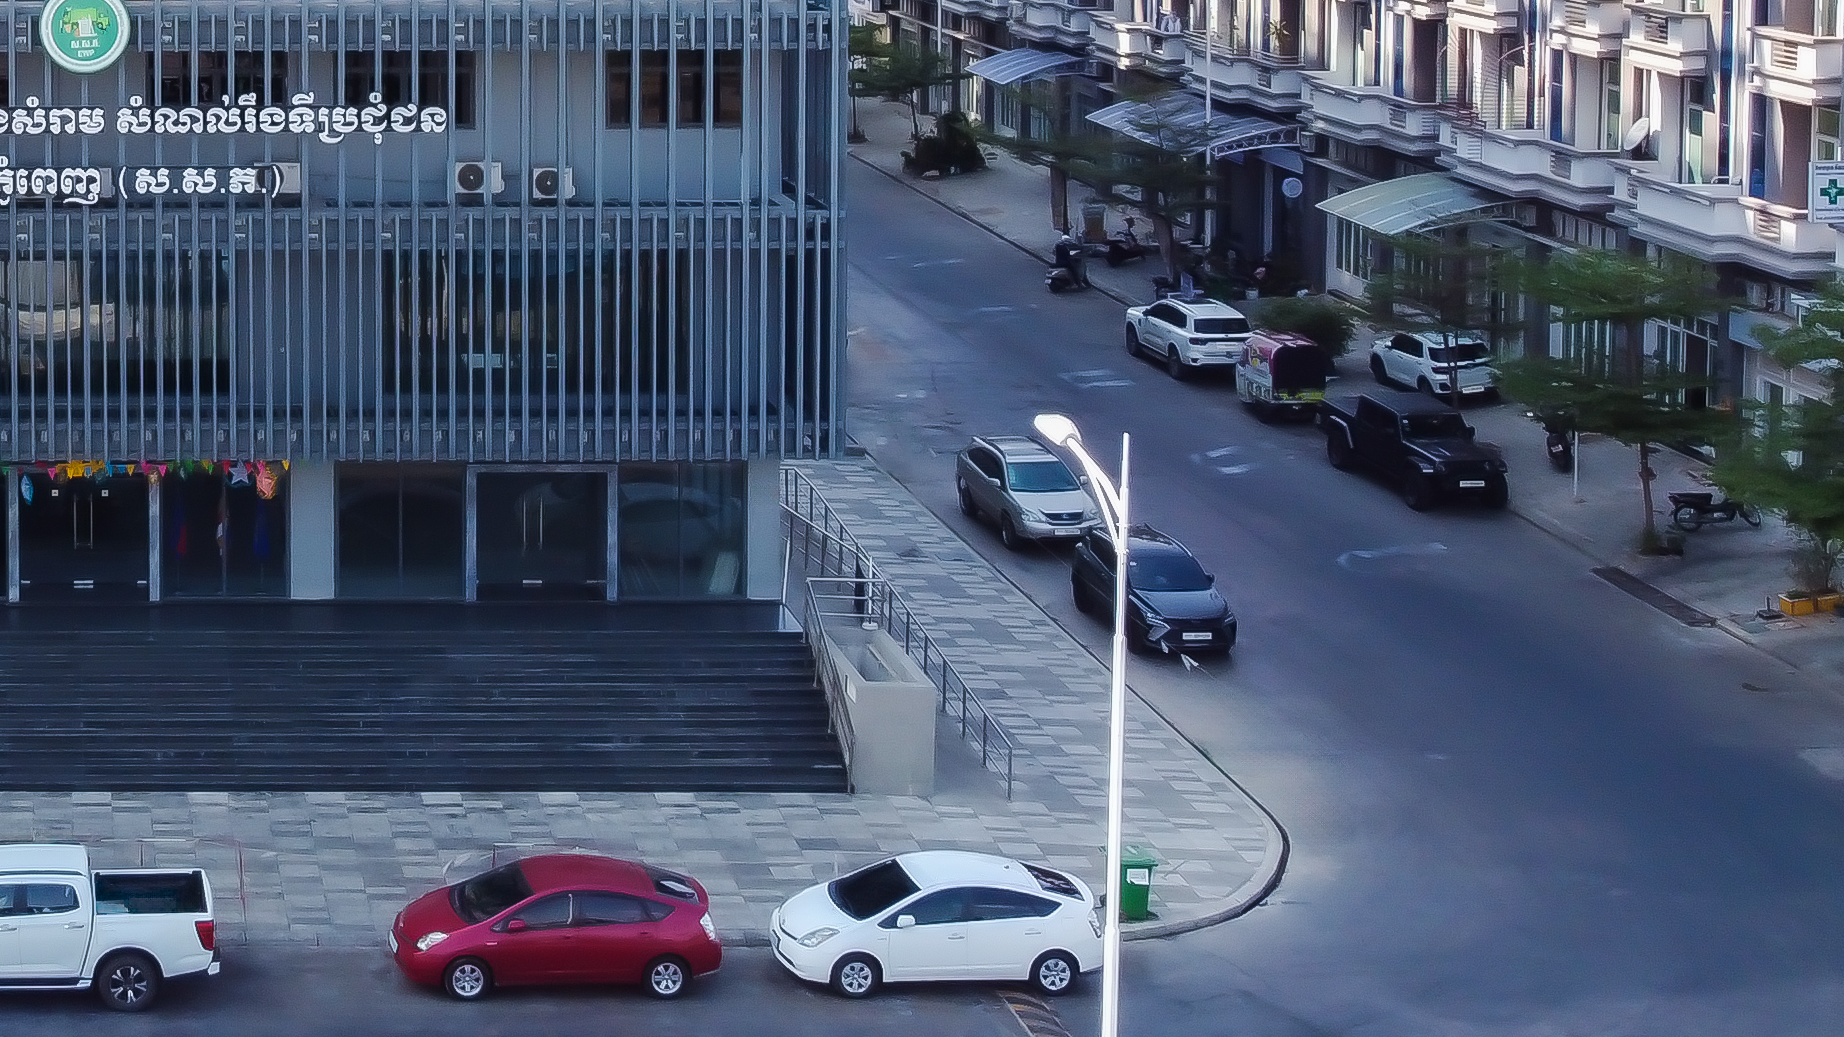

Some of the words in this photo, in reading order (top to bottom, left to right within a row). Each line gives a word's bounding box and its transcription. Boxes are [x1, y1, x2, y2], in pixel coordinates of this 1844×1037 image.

[116, 91, 448, 146] សំណល់រឹងទីប្រជុំជន
